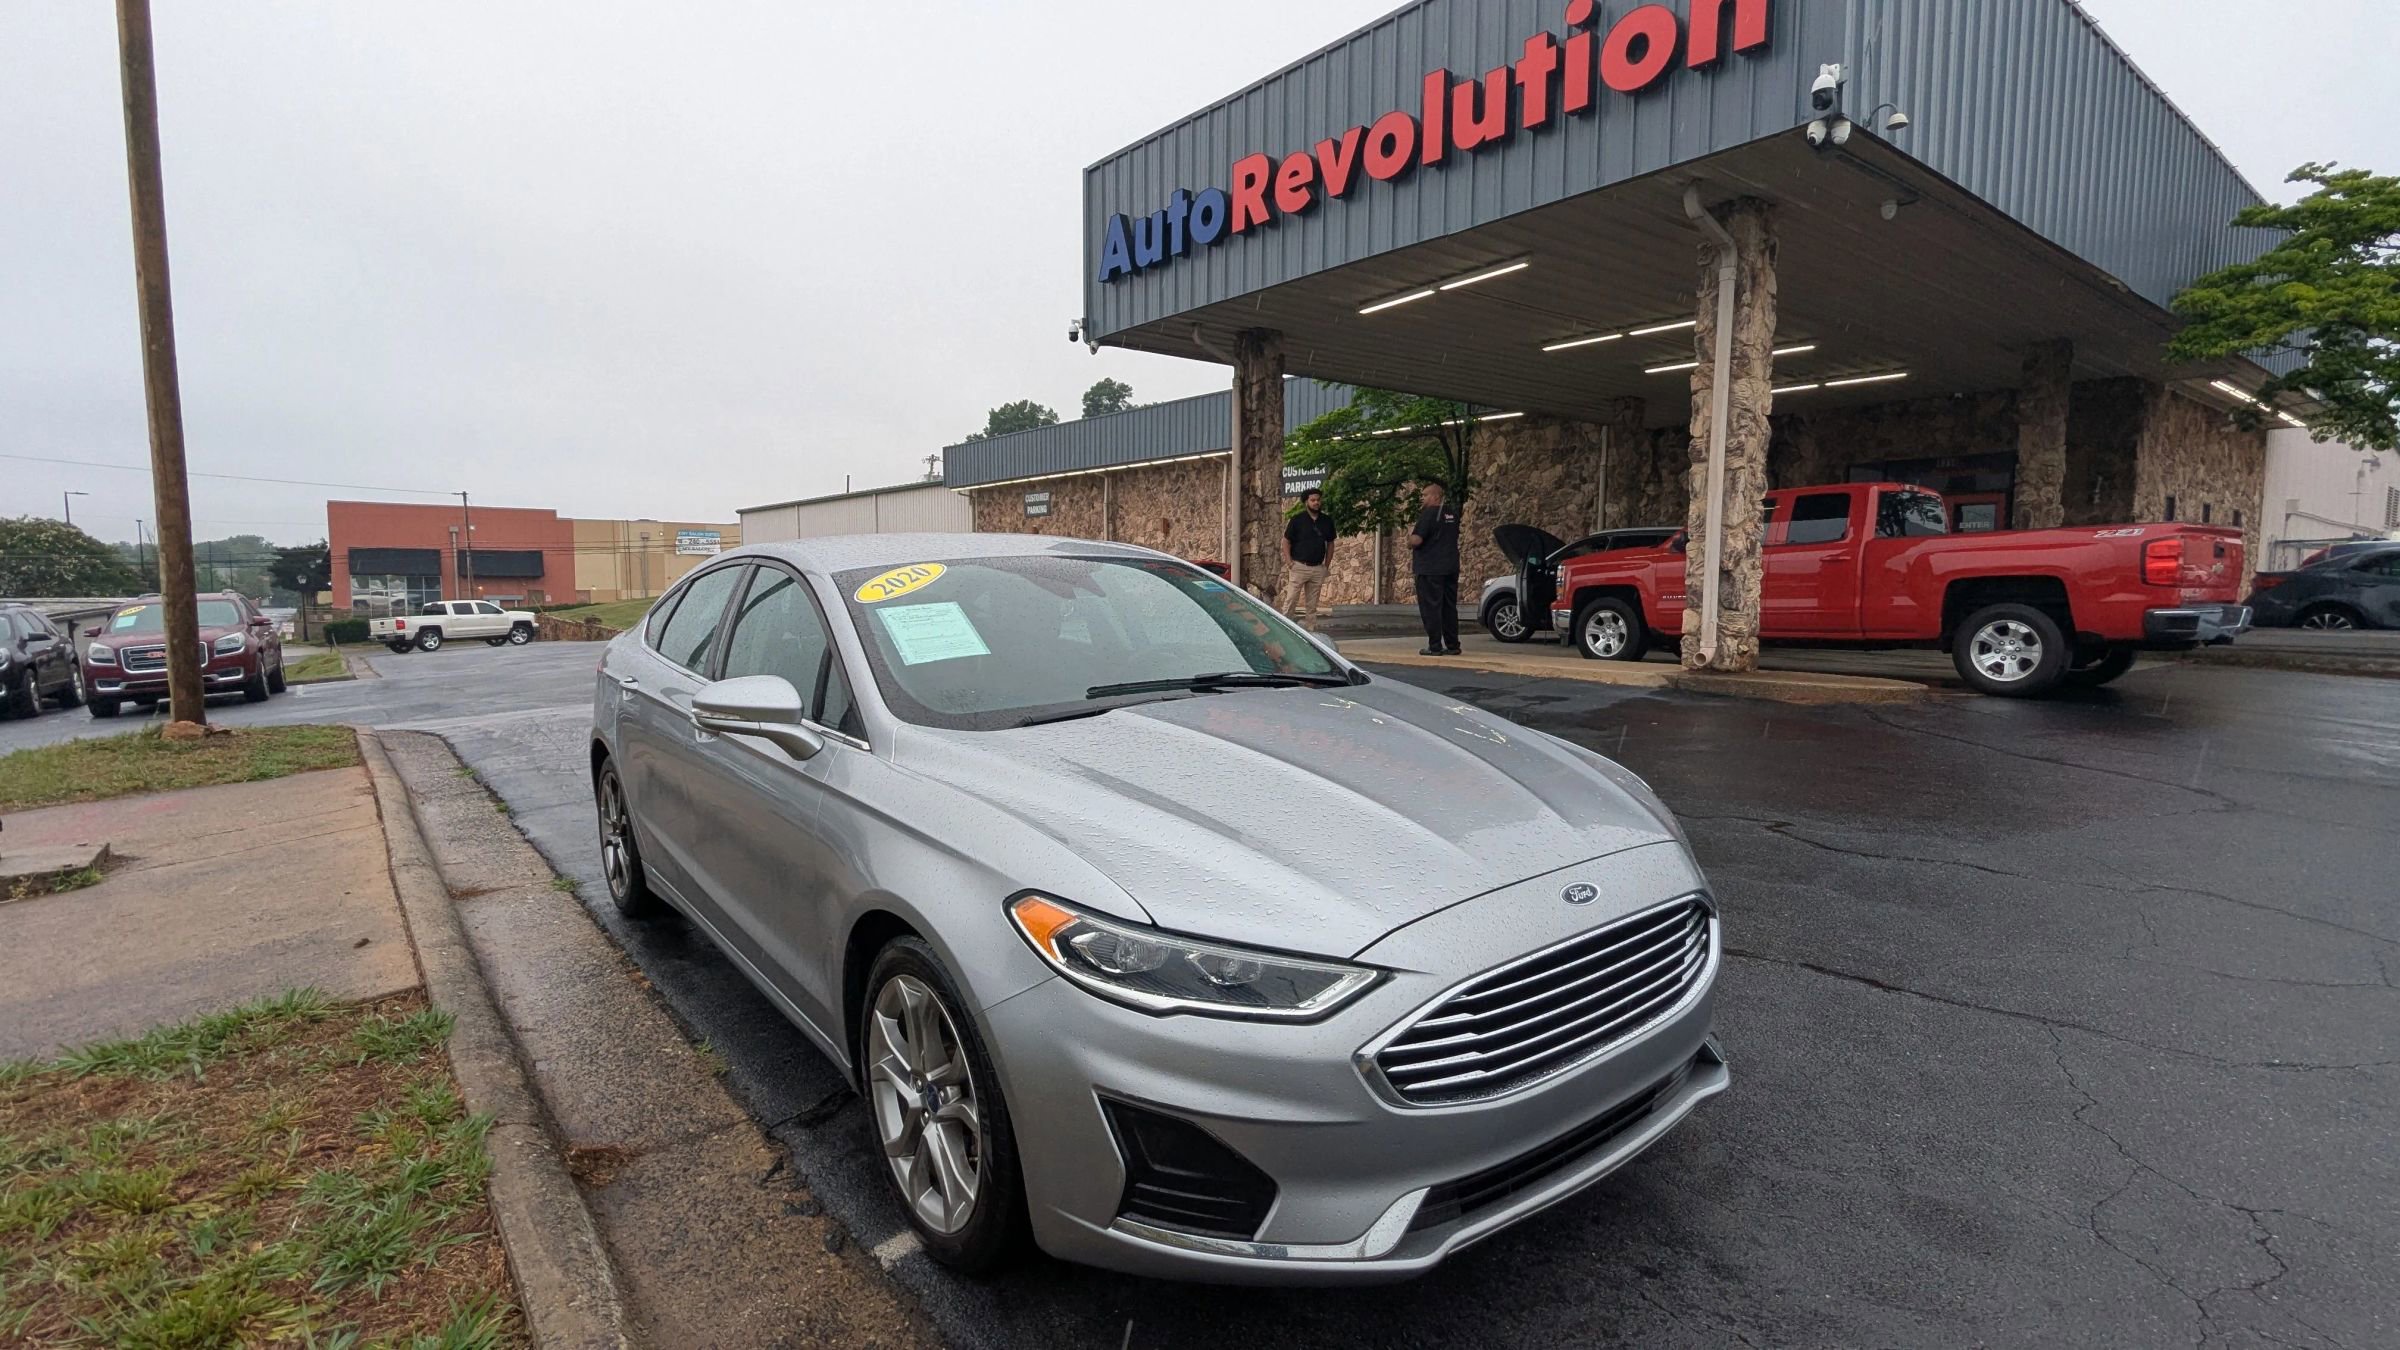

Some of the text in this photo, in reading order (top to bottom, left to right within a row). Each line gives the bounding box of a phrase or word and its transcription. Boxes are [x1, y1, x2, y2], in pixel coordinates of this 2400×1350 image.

[1025, 492, 1050, 503] CUSTOMER
[1027, 505, 1048, 514] PARKING
[870, 567, 931, 595] 2020
[147, 651, 167, 659] GM
[1568, 886, 1593, 902] Ford
